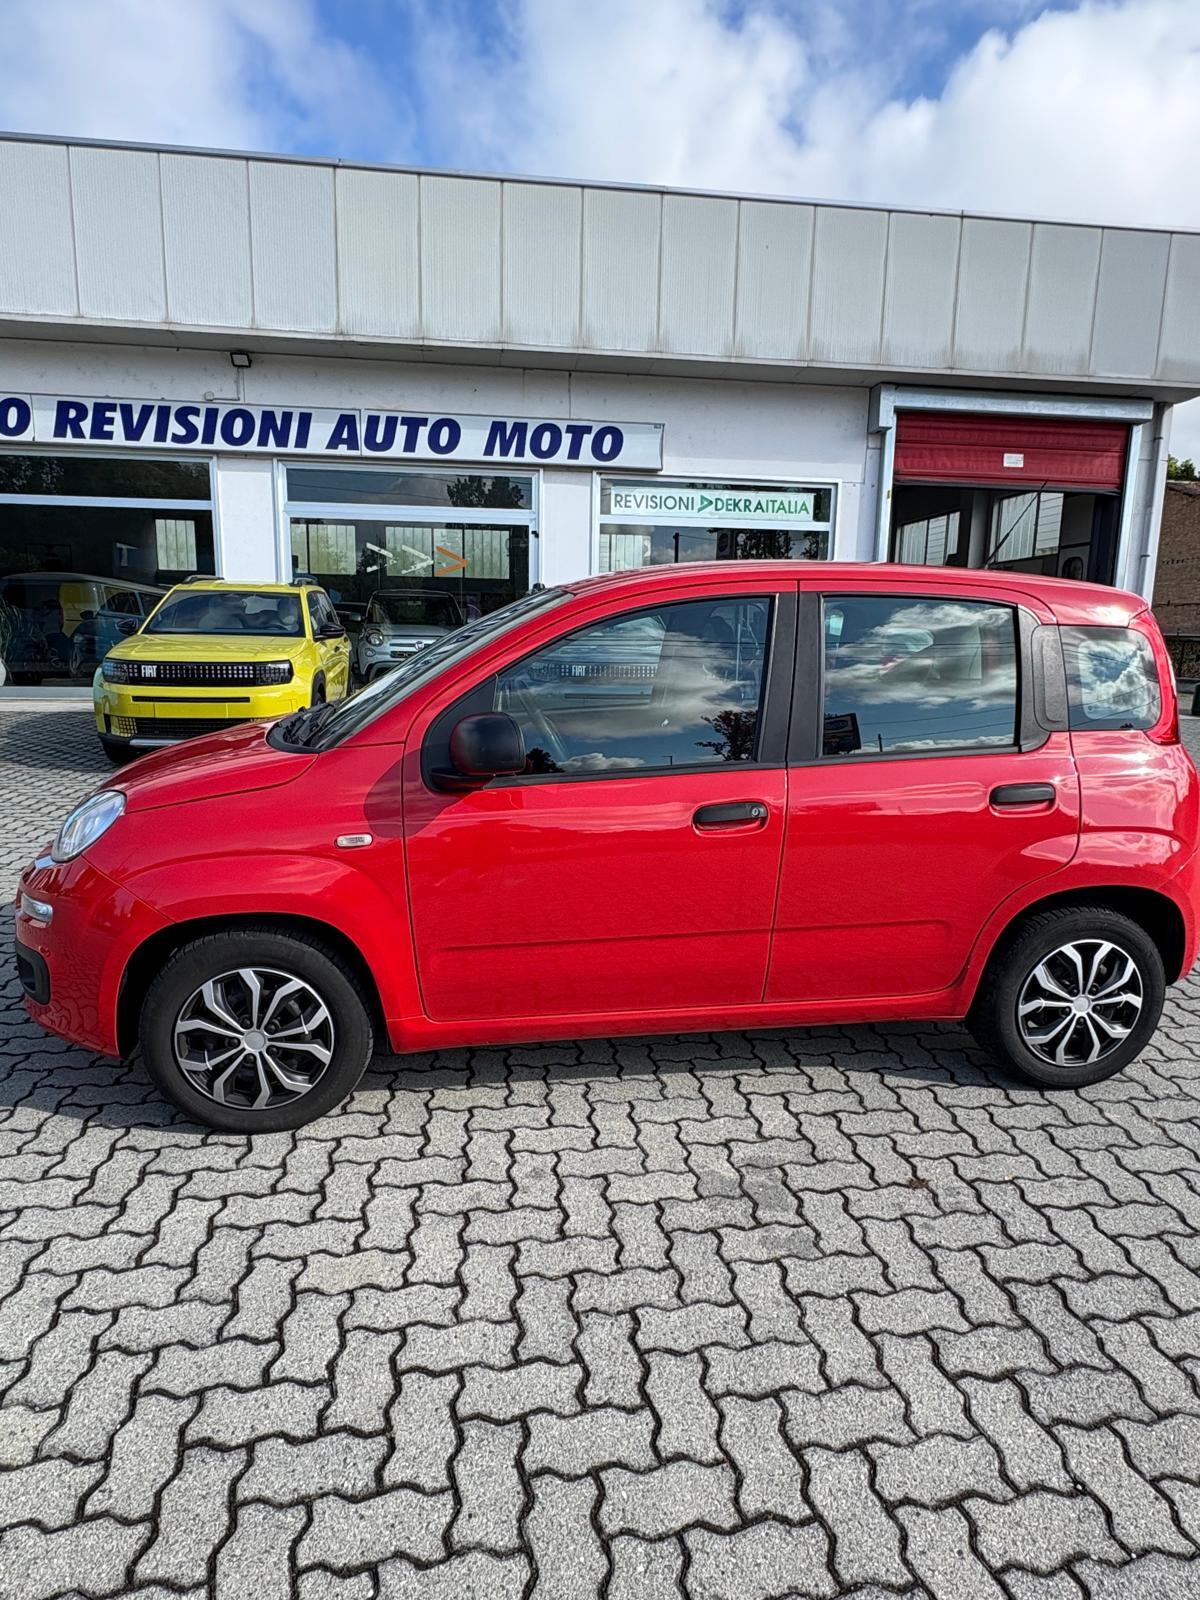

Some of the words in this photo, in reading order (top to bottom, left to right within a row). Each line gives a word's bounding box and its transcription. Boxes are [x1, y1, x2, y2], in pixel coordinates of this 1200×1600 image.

[0, 397, 31, 437] O
[53, 400, 312, 449] REVISIONI
[325, 413, 462, 455] AUTO
[483, 420, 624, 462] MOTO
[614, 494, 694, 511] REVISIONI
[141, 665, 157, 678] FIAT
[571, 665, 586, 677] FIAT
